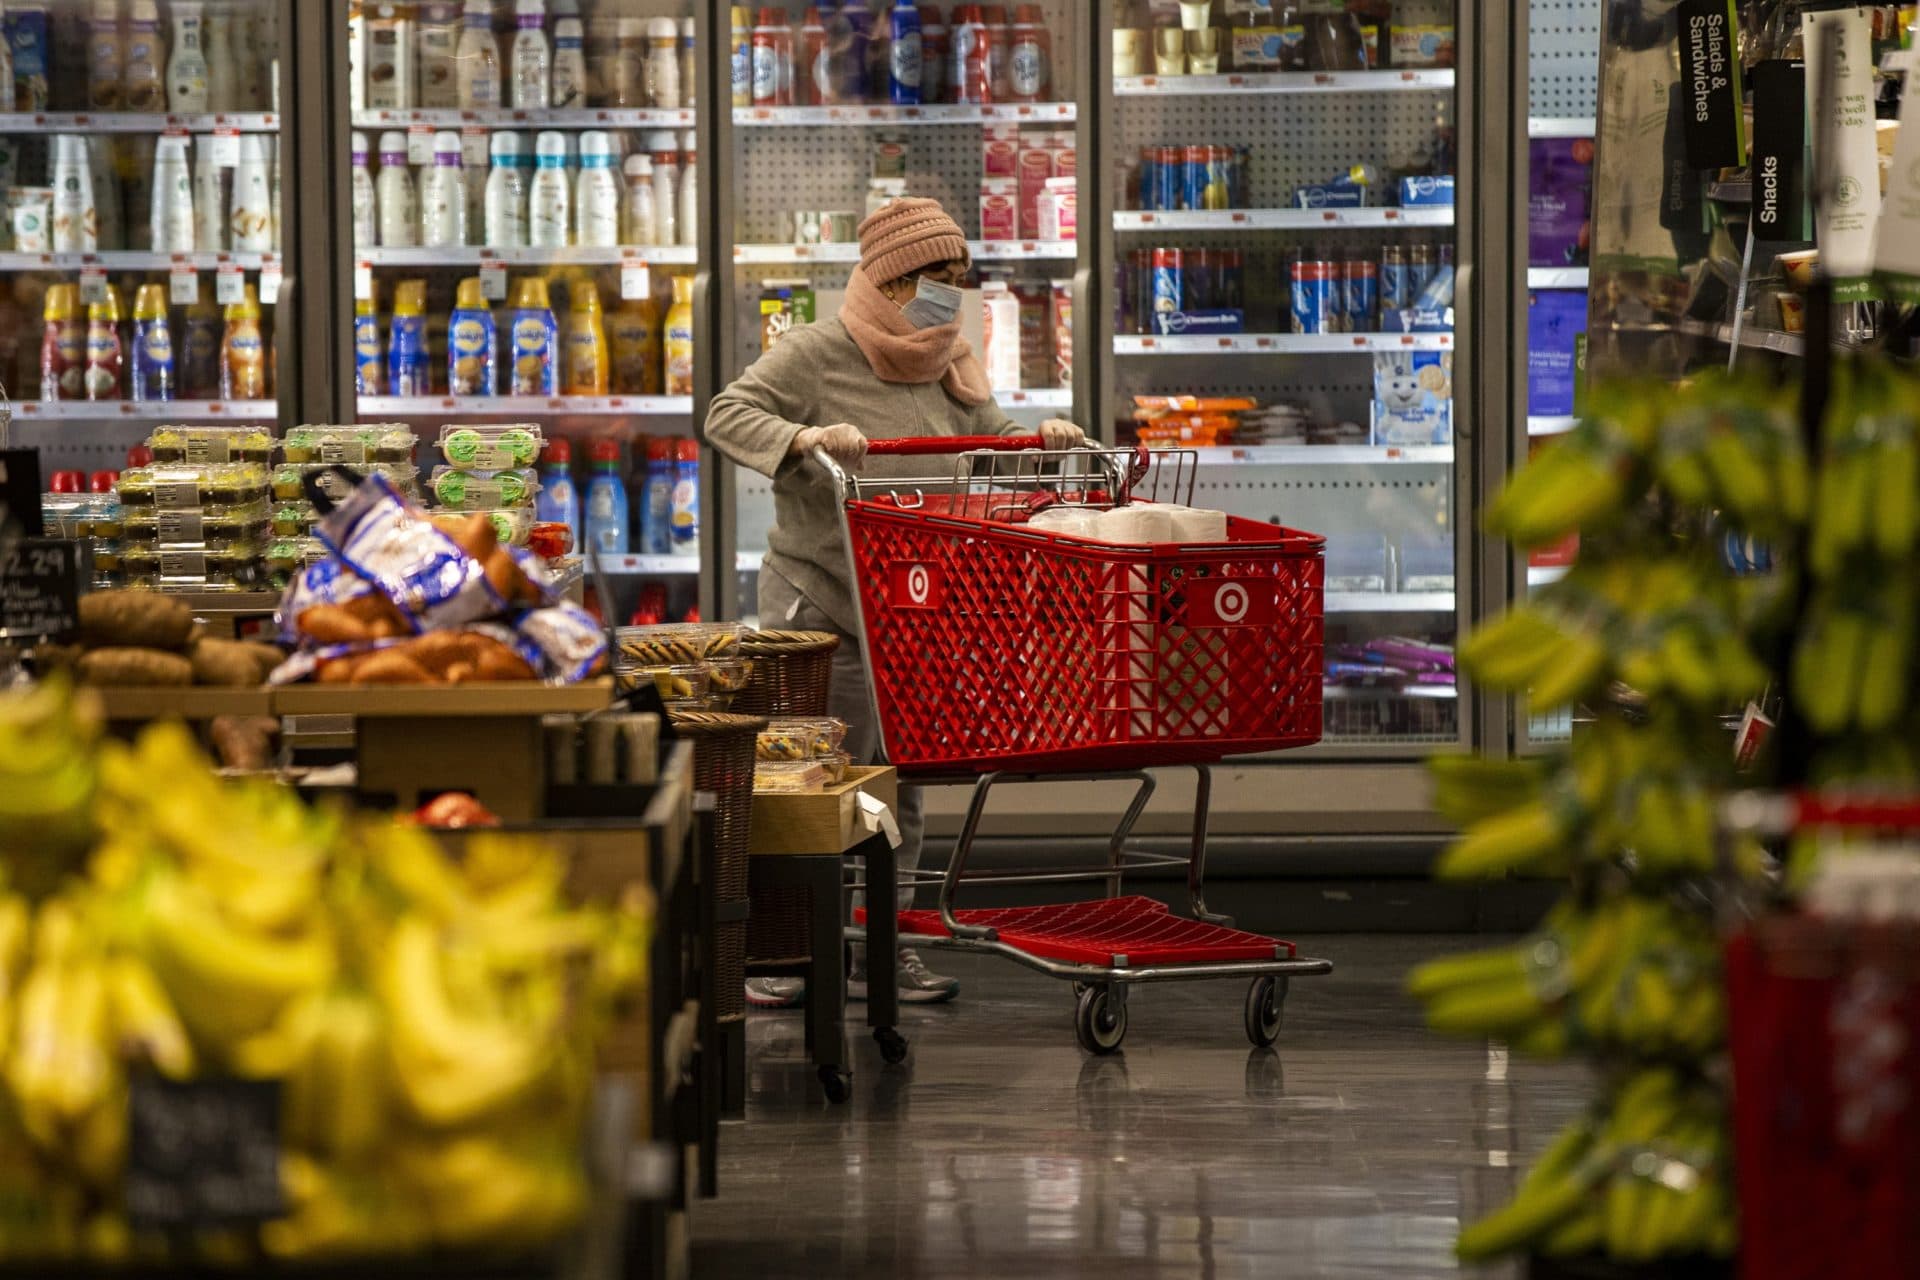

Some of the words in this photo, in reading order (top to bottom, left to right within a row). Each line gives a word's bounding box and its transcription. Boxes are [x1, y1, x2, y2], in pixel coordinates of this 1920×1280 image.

[1707, 14, 1725, 73] Salads
[1690, 16, 1709, 122] Sandwiches
[1711, 77, 1727, 90] &
[1844, 104, 1866, 114] well
[1845, 117, 1863, 128] day
[1760, 156, 1778, 224] Snacks
